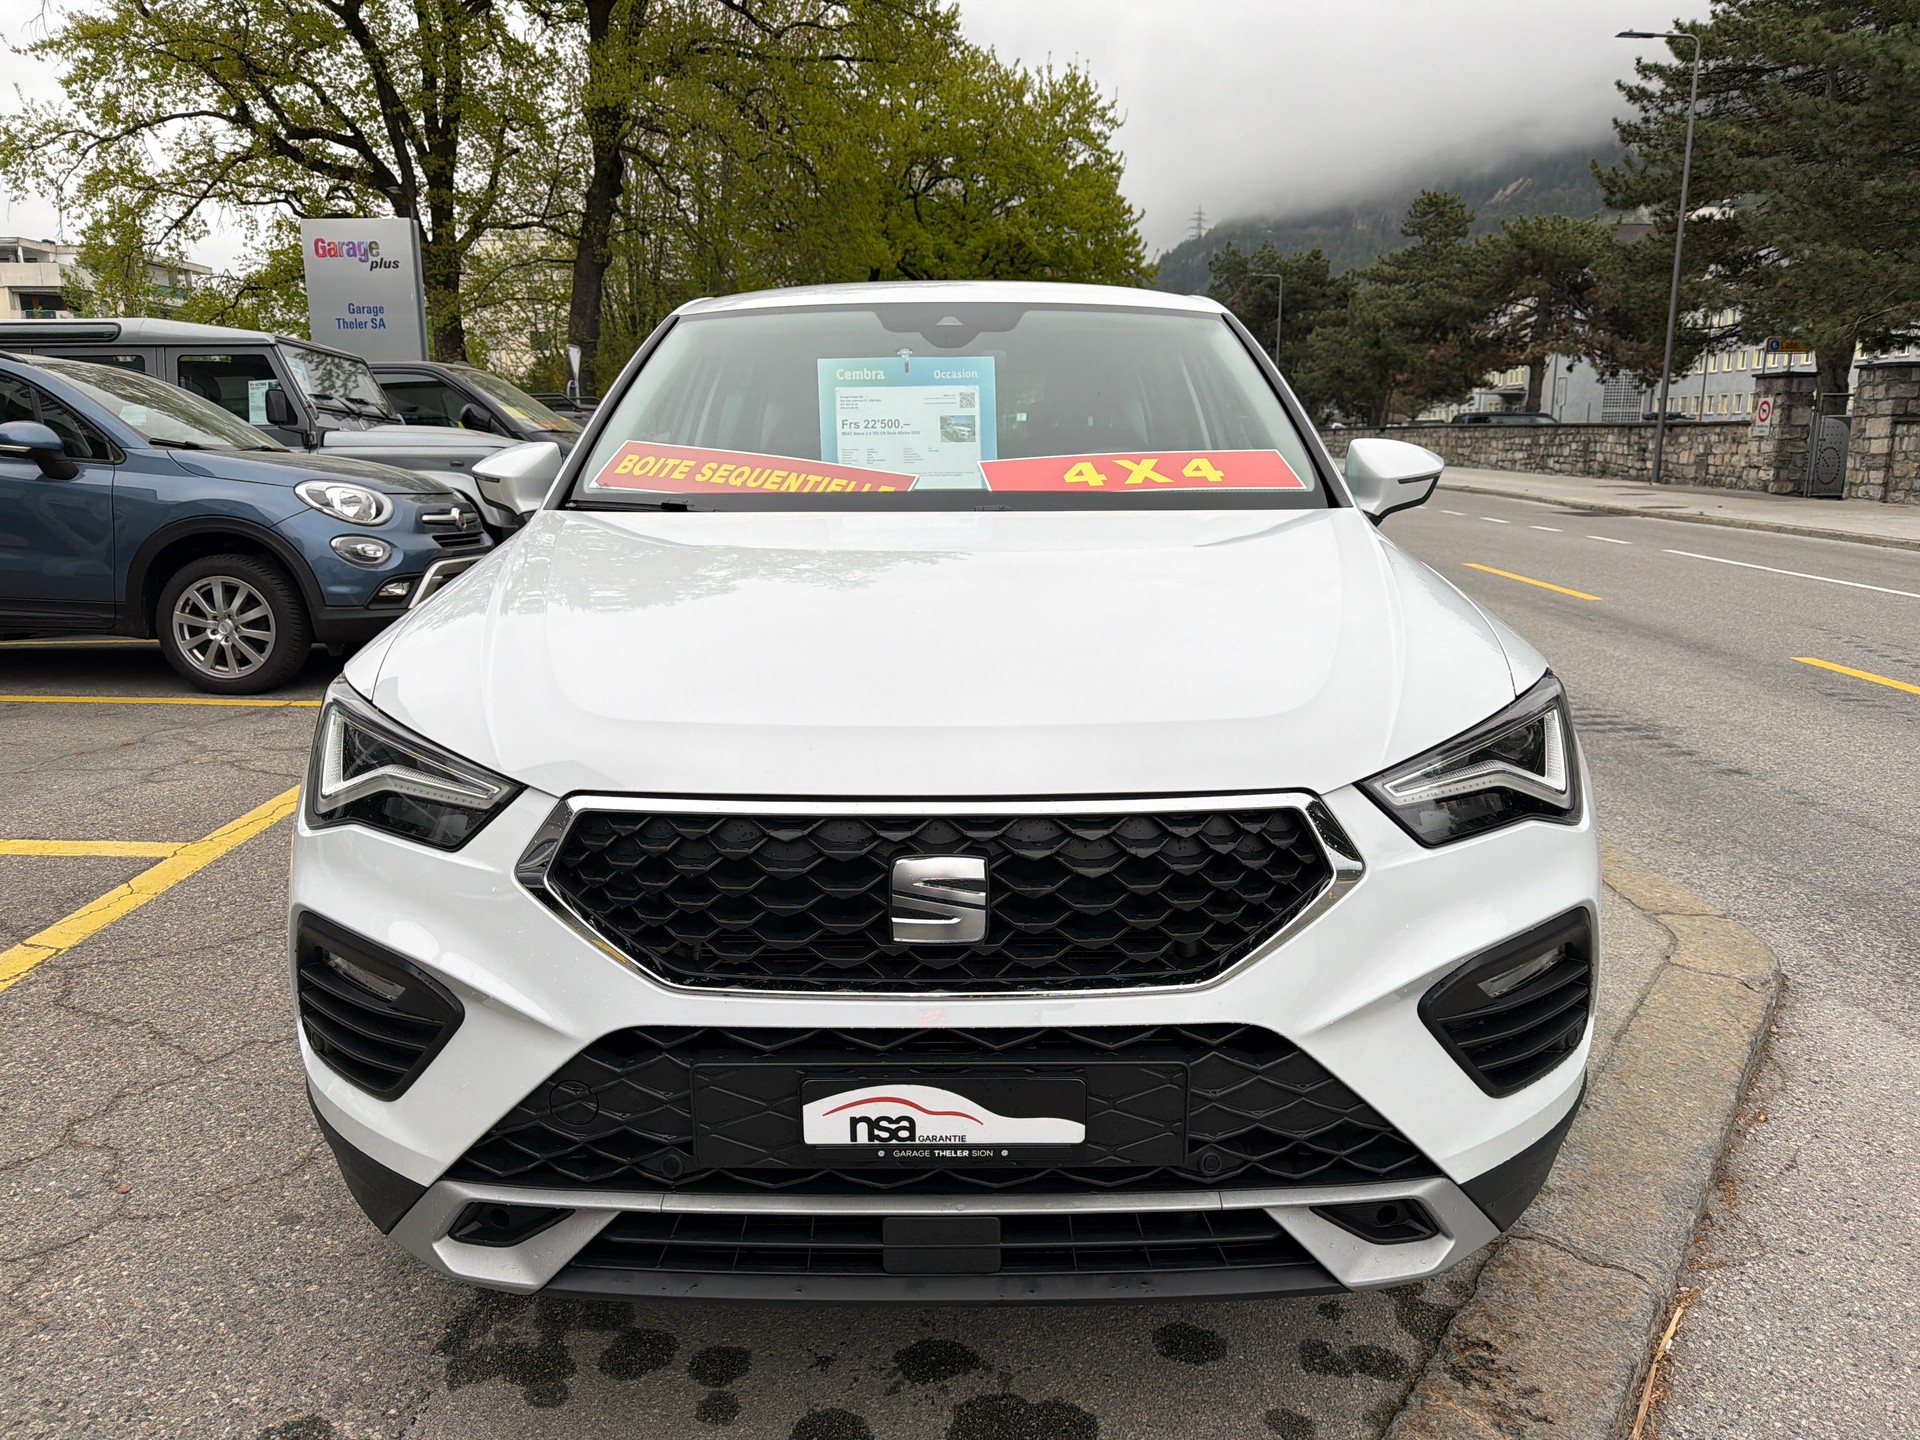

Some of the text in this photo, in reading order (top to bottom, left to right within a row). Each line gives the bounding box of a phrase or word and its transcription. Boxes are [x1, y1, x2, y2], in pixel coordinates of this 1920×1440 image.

[314, 238, 380, 263] Garage
[370, 258, 400, 271] plus
[348, 303, 385, 316] Garage
[336, 318, 386, 329] Theler SA
[836, 368, 885, 380] Cembra
[933, 369, 978, 379] Occasion
[841, 419, 860, 429] Frs
[613, 453, 697, 480] BOITE
[849, 1115, 967, 1143] nsa GARANTIE
[893, 1149, 994, 1158] GARAGE THELER SION
